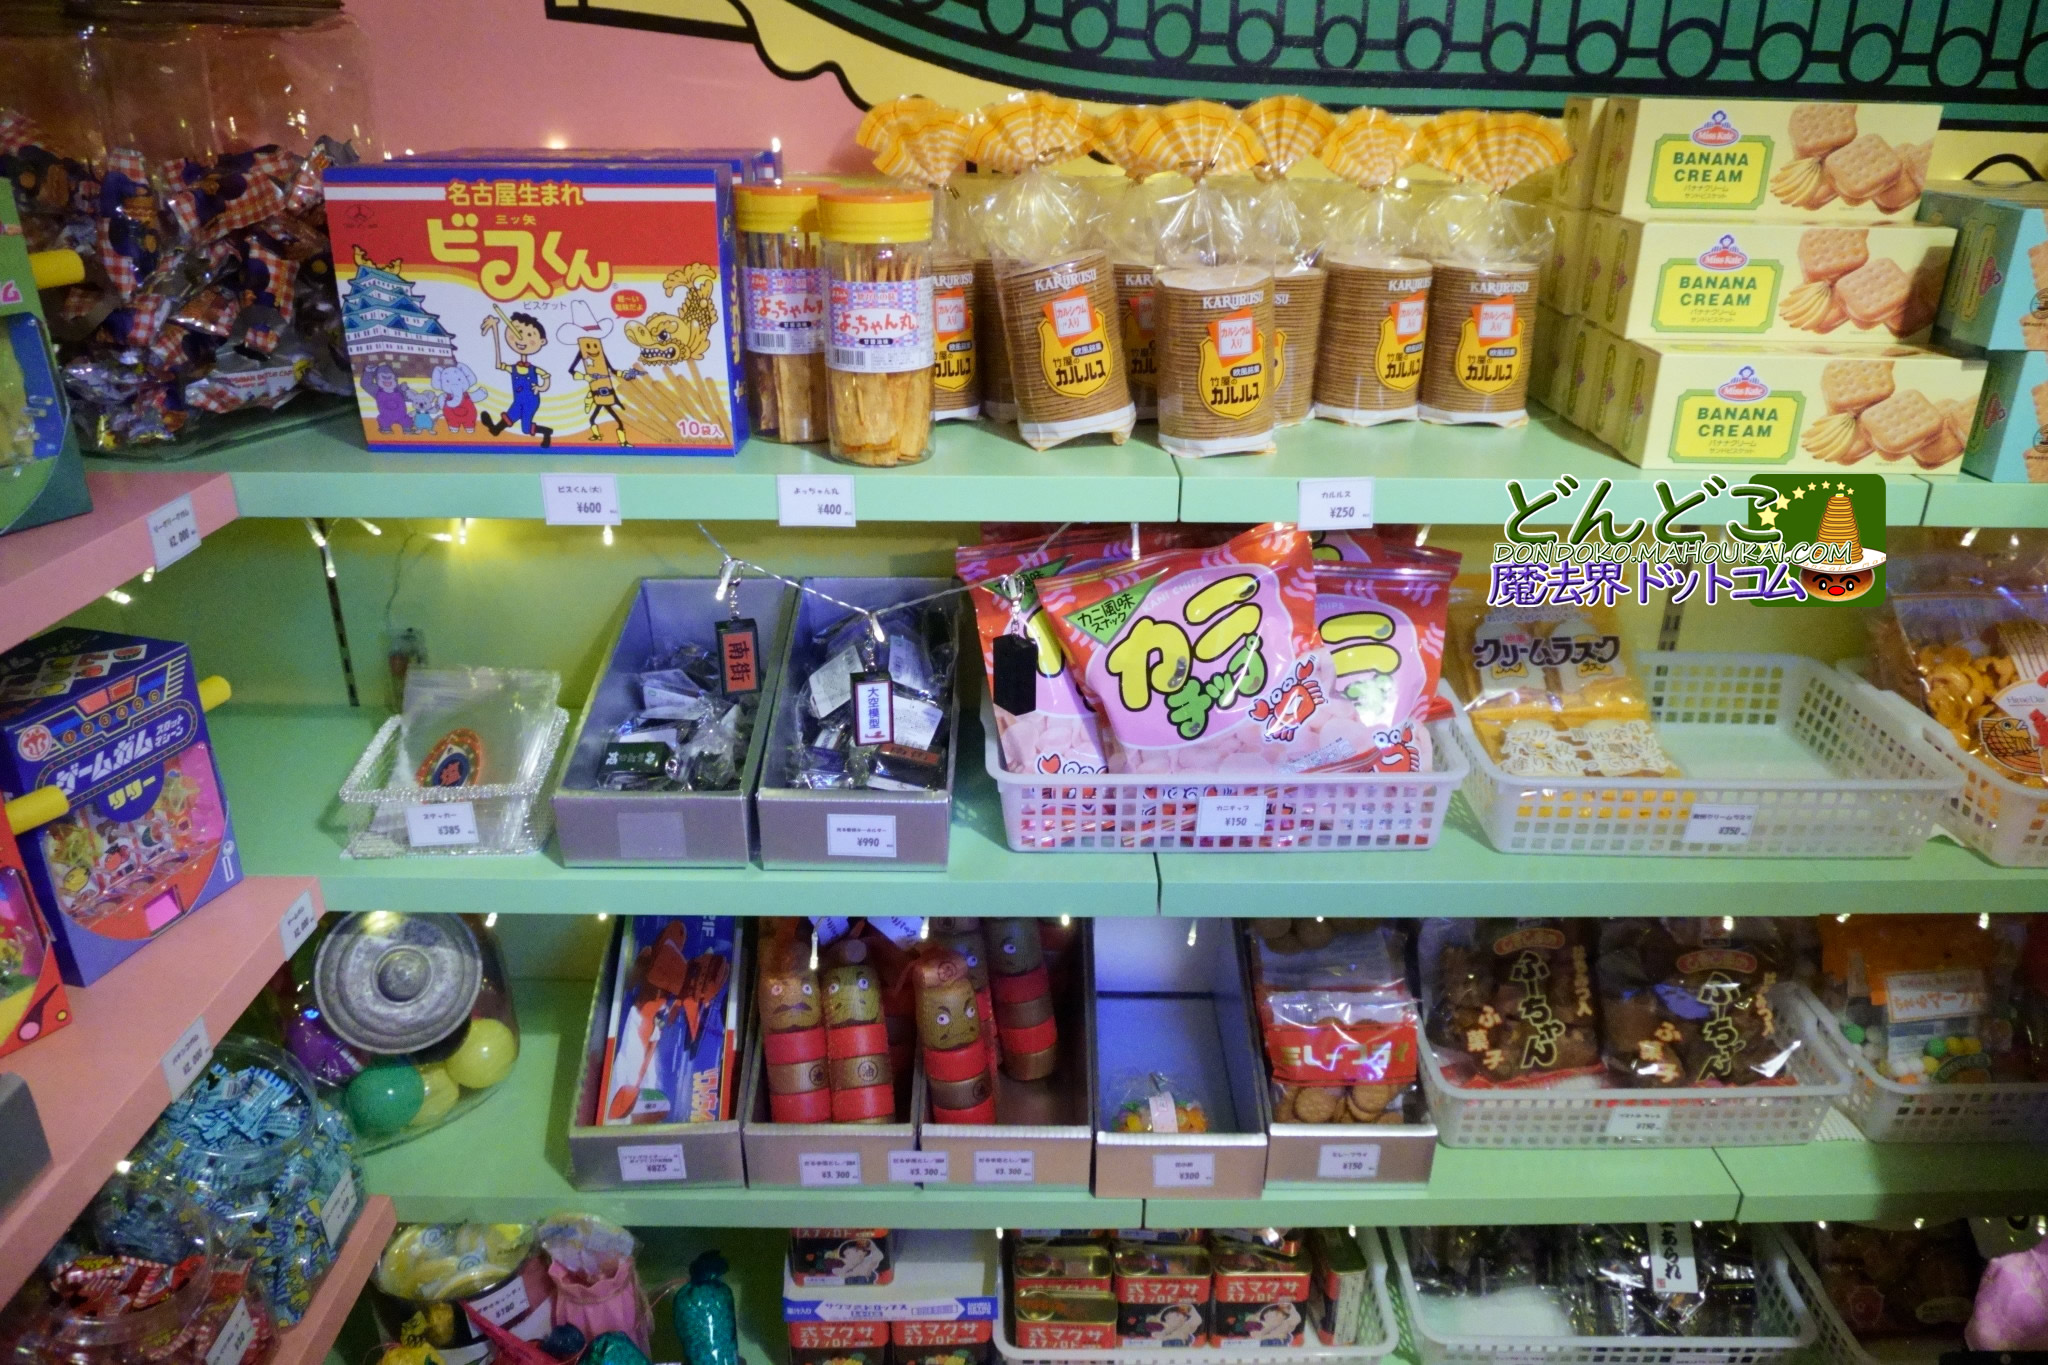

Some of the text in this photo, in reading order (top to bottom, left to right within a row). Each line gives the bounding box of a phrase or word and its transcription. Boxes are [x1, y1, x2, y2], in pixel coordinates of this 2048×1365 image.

[1673, 152, 1748, 166] BANANA
[1674, 169, 1743, 182] CREAM
[447, 182, 584, 207] 名古屋生まれ
[427, 214, 613, 299] ビスくん
[1034, 269, 1097, 292] KARURUSU
[1470, 280, 1530, 295] KARURUSU
[1678, 276, 1757, 290] BANANA
[523, 301, 567, 311] ビスケット
[1202, 290, 1265, 310] KARURUSU
[1680, 293, 1751, 306] CREAM
[1056, 304, 1089, 319] カルシウム
[837, 311, 917, 336] よっちゃん丸
[1067, 317, 1081, 328] 入り
[1220, 326, 1250, 338] カルシウム
[1231, 337, 1243, 350] 入り
[1697, 407, 1778, 421] BANANA
[678, 420, 724, 438] 10袋入
[1698, 424, 1772, 438] CREAM
[793, 486, 840, 496] よっちゃん丸
[1321, 490, 1352, 499] カルルス
[576, 501, 602, 514] ¥600
[817, 502, 842, 515] ¥400
[1329, 506, 1355, 518] ¥250
[1076, 593, 1136, 628] カニ風味
[1317, 601, 1345, 610] HIPS
[1091, 612, 1128, 634] スナック
[1106, 573, 1264, 712] カニ
[1473, 635, 1621, 669] クリームラスク
[866, 686, 880, 730] 大空模型
[156, 714, 184, 735] スロット
[56, 729, 154, 796] ゲームガム
[424, 811, 457, 821] ステッカー
[1225, 817, 1247, 827] ¥150
[437, 824, 461, 836] ¥385
[856, 837, 880, 848] ¥990
[1511, 950, 1567, 1069] ふーちゃん
